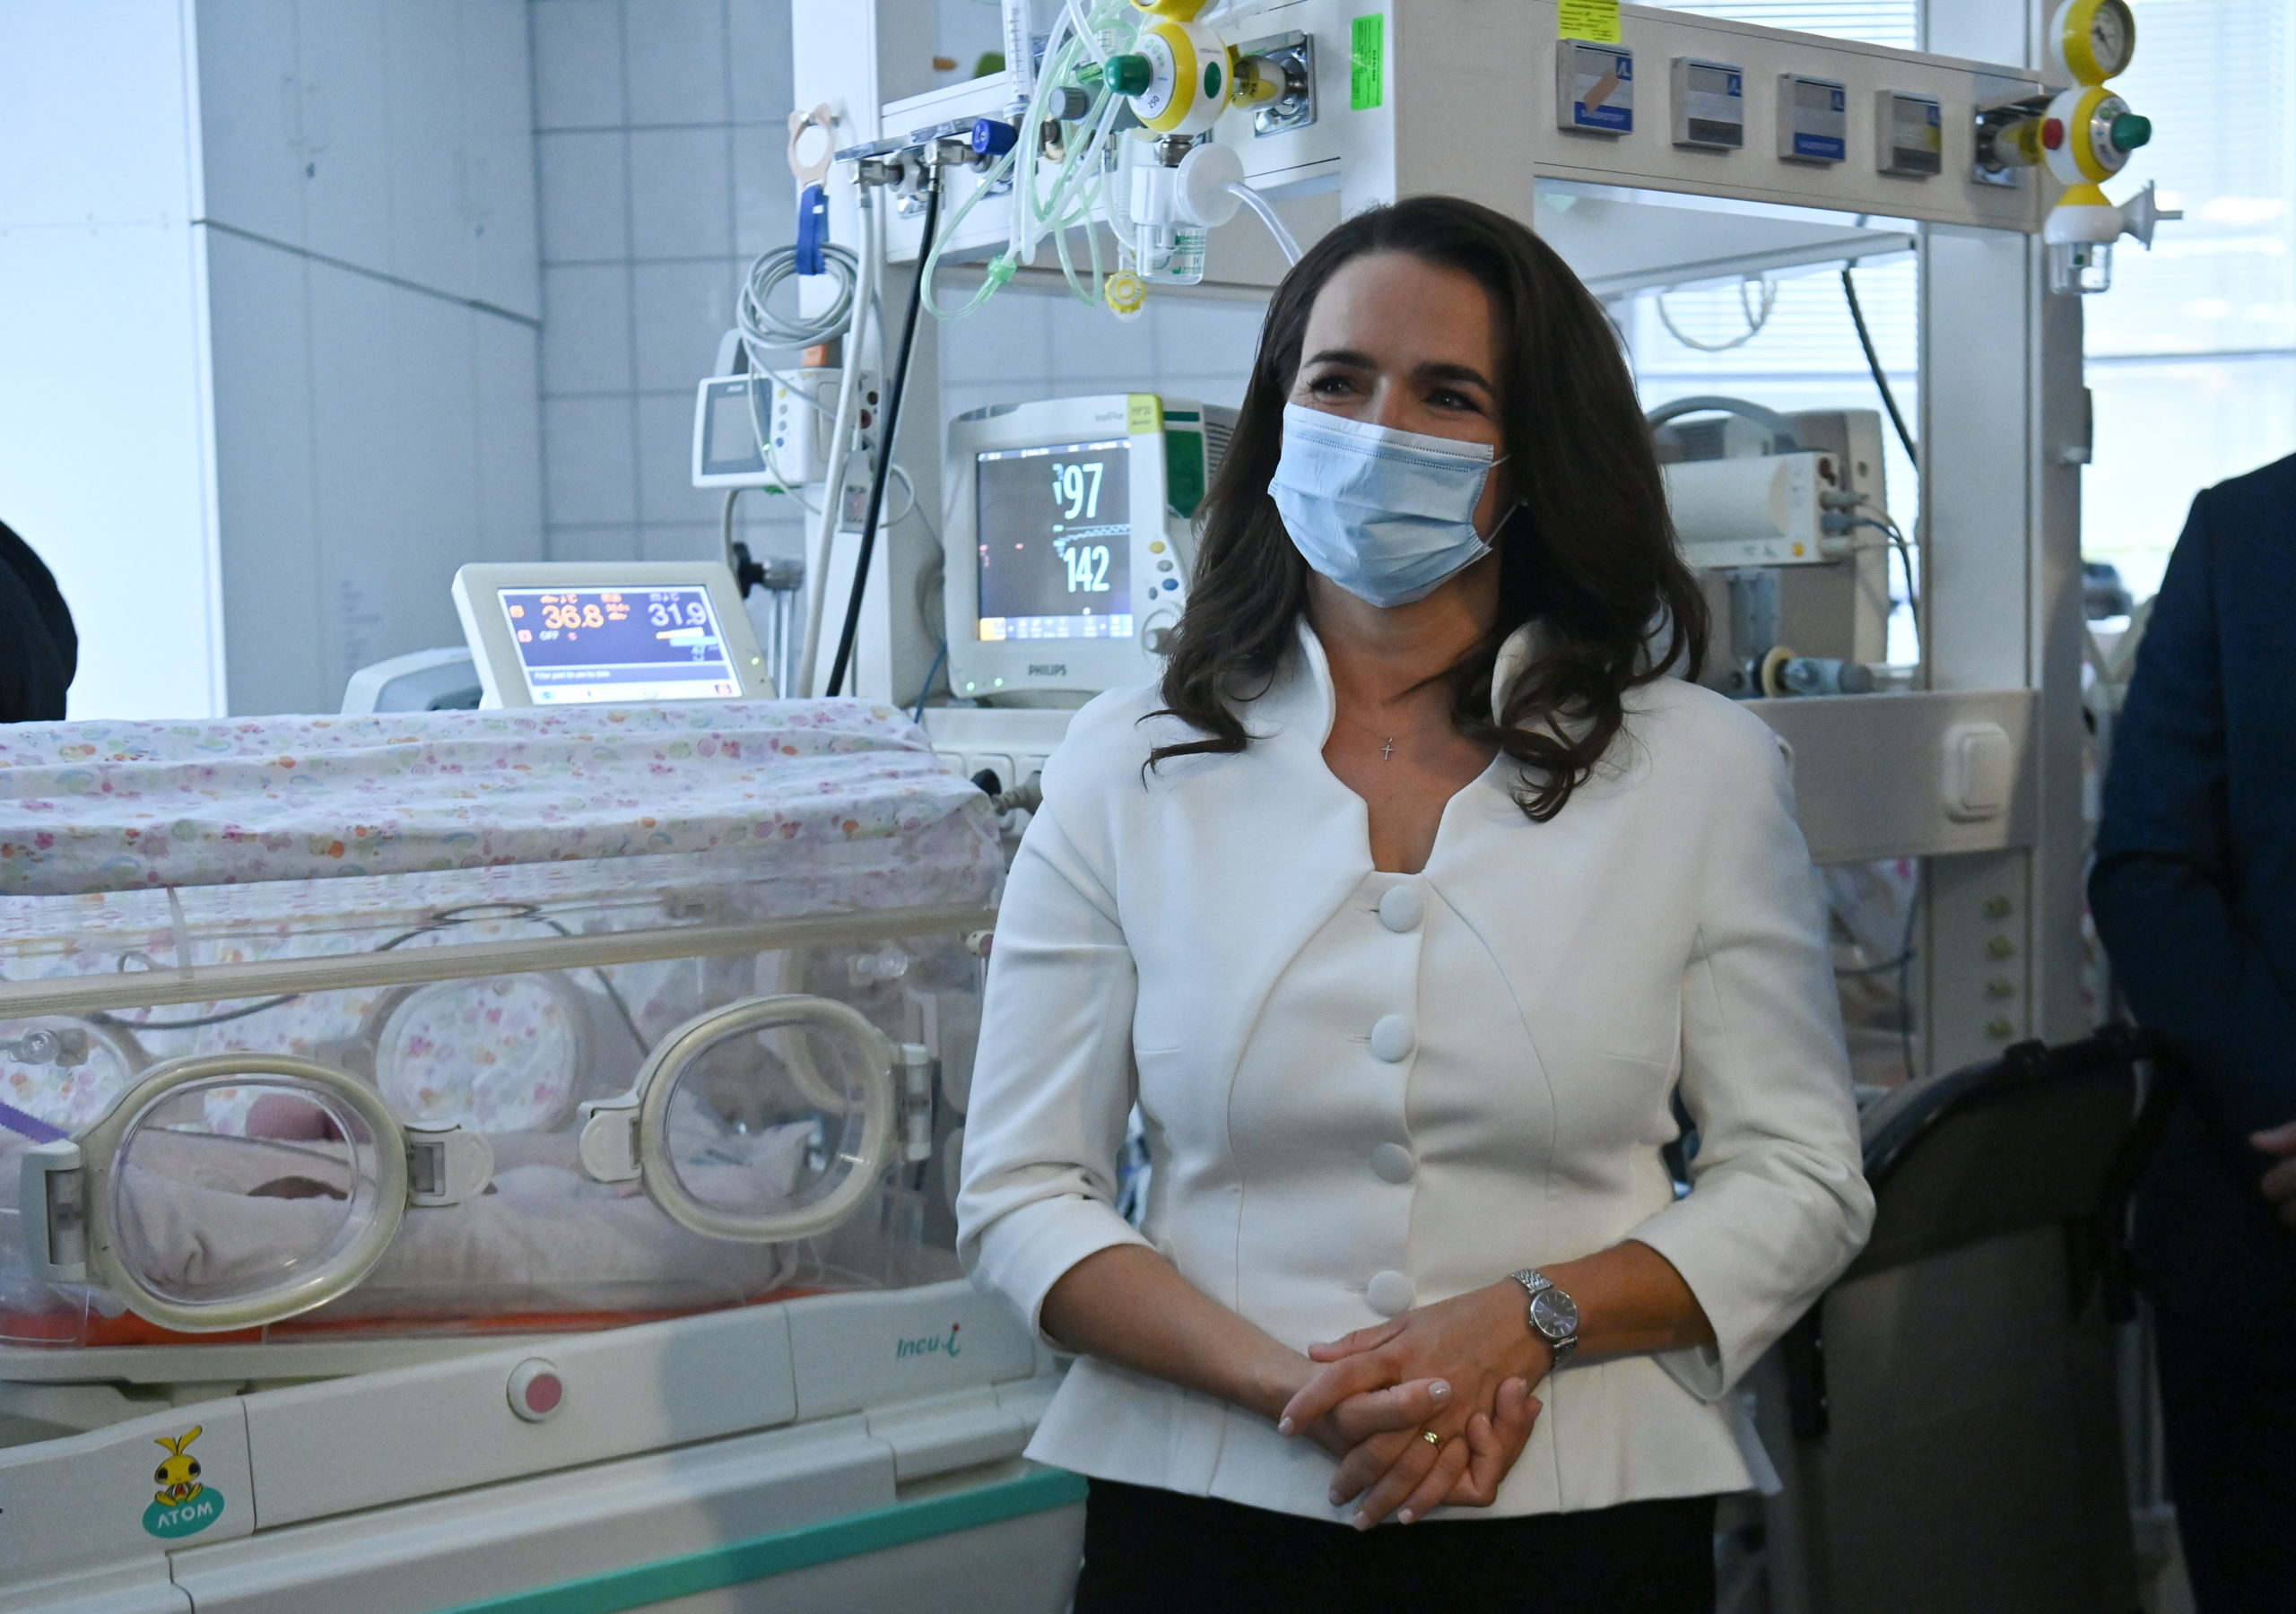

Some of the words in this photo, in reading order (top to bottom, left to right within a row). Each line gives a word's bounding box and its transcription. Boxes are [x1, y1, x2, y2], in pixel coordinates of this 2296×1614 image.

[1147, 95, 1161, 109] 250
[1063, 463, 1104, 520] 97
[1063, 545, 1110, 593] 142
[542, 603, 604, 629] 36.8
[648, 602, 707, 627] 31.9
[538, 629, 561, 641] OFF
[1029, 664, 1067, 676] PHILIPS
[157, 1501, 213, 1529] ATOM
